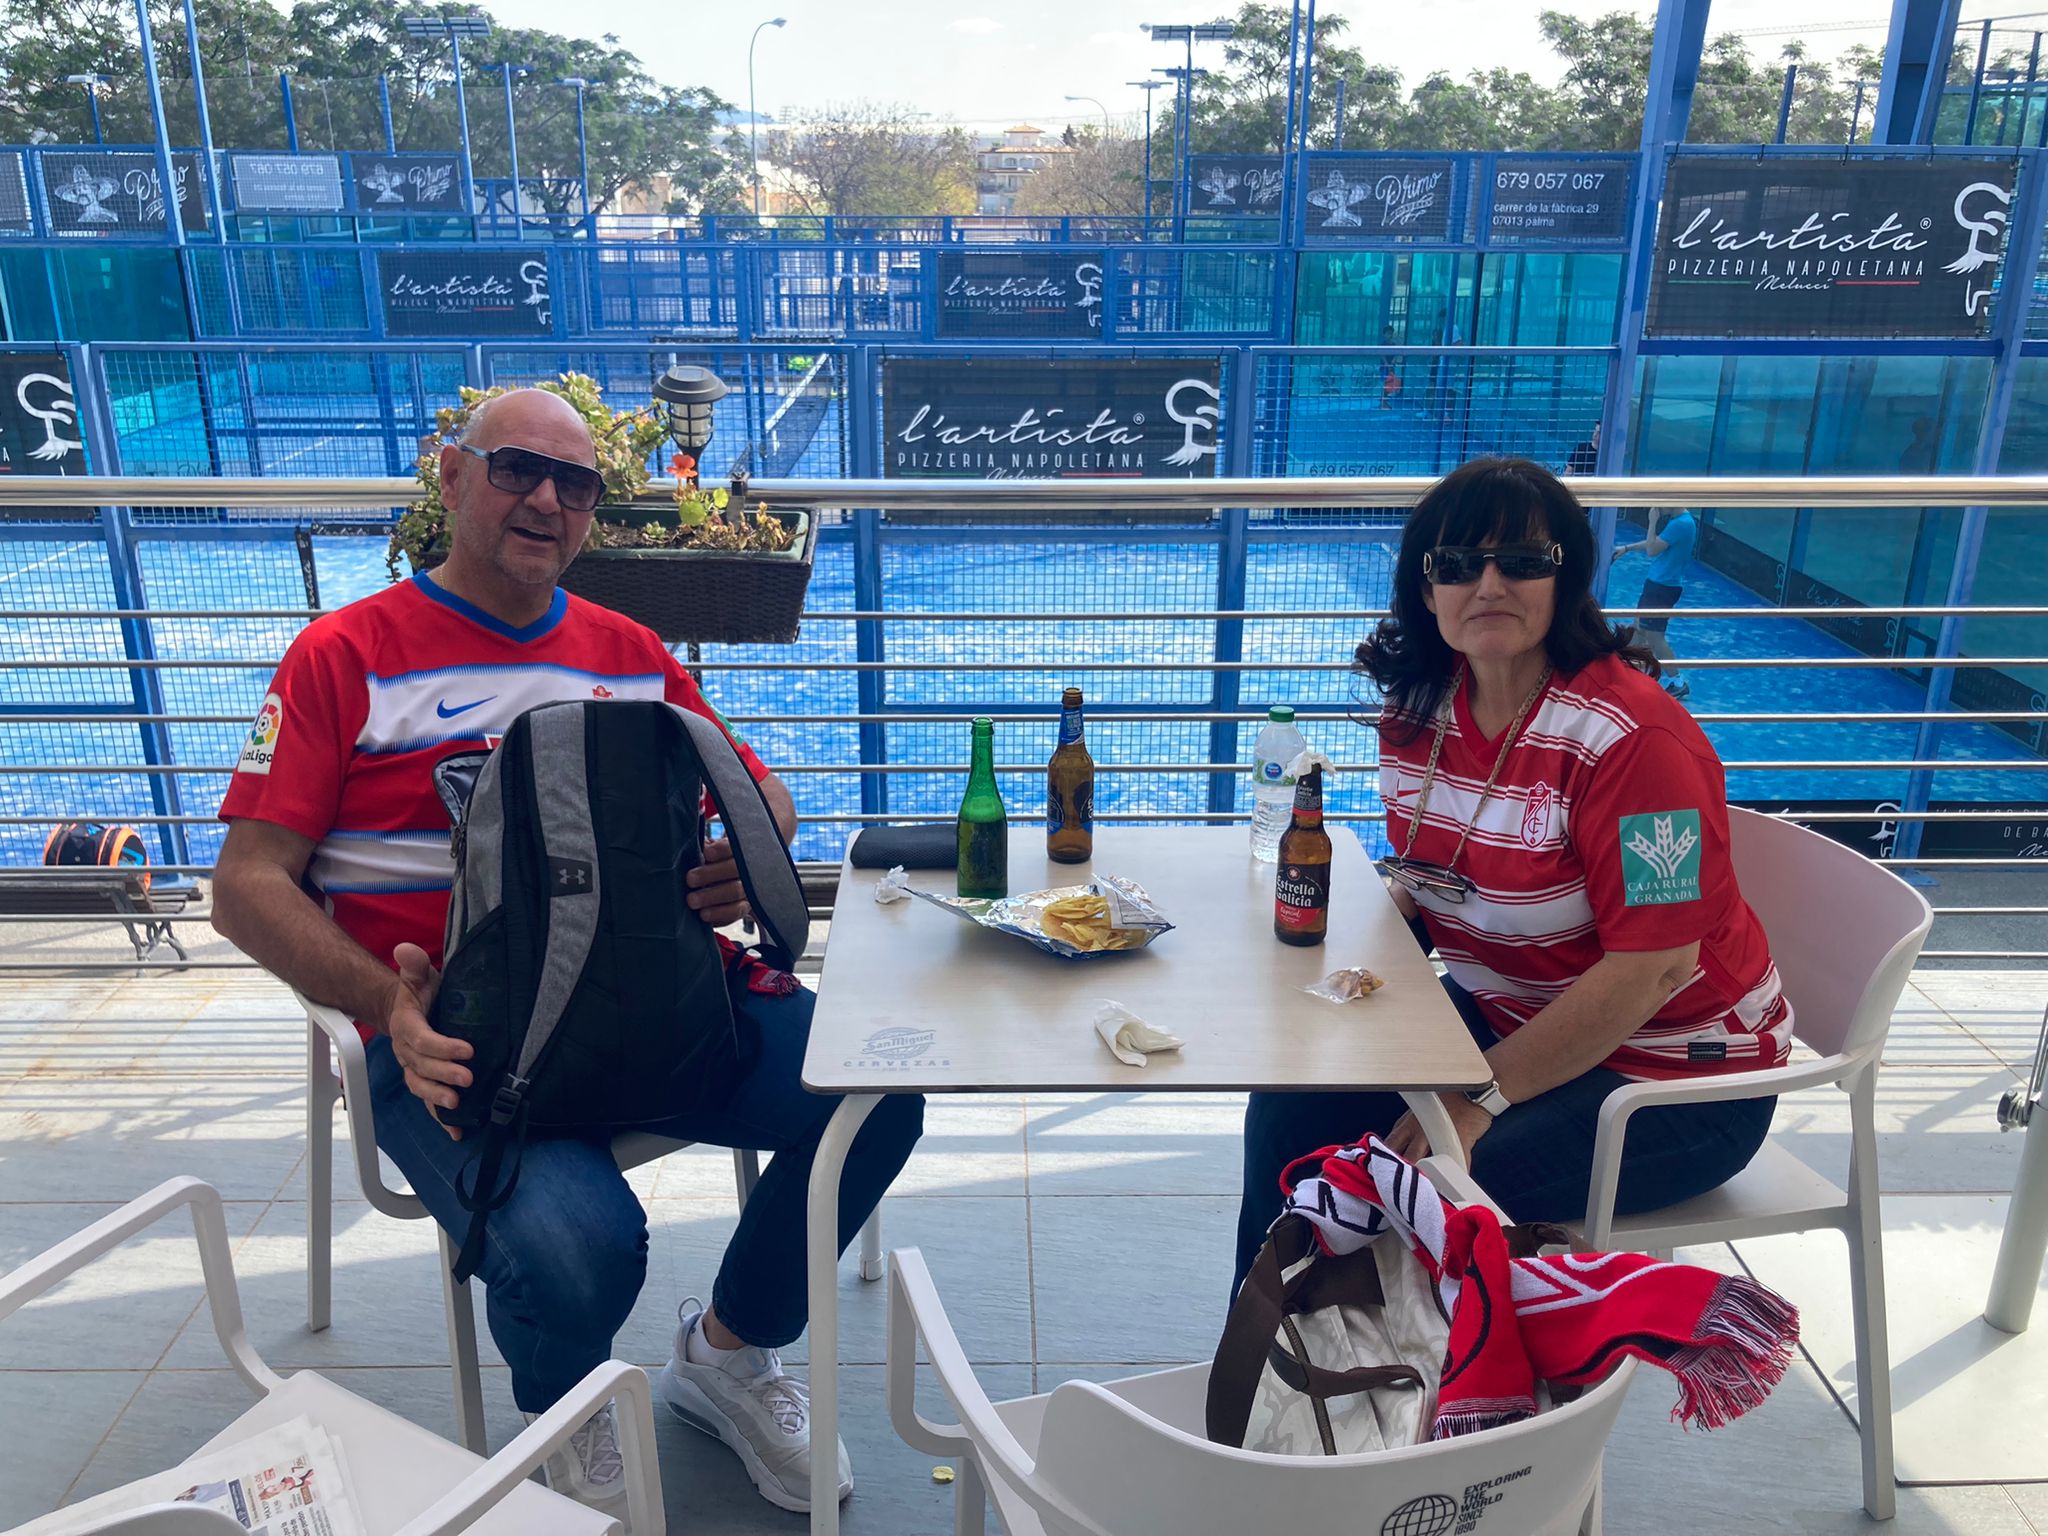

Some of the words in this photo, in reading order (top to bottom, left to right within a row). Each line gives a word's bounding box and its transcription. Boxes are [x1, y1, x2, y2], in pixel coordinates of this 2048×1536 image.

[1497, 172, 1529, 189] 679
[1535, 173, 1567, 189] 057
[1572, 173, 1605, 190] 067
[1375, 172, 1443, 226] Primo
[1494, 203, 1523, 213] carrer
[1525, 203, 1538, 213] de
[1540, 203, 1549, 213] la
[1586, 203, 1599, 213] 29
[1492, 216, 1523, 226] 07013
[1525, 216, 1555, 228] palma
[1668, 259, 1768, 275] PIZZERIA
[1786, 260, 1924, 276] NAPOLETANA
[1754, 274, 1832, 290] Melucci
[898, 452, 996, 468] PIZZERIA
[1011, 452, 1144, 468] NAPOLETANA
[1339, 465, 1365, 477] 057
[1369, 465, 1394, 477] 067
[2003, 826, 2023, 838] DE
[1276, 875, 1315, 895] Estrella
[1627, 881, 1660, 892] CAJA
[1663, 876, 1697, 889] RURAL
[1276, 886, 1312, 907] Galicia
[1634, 890, 1693, 904] GRANADA
[1464, 1466, 1532, 1495] EXPLORING
[1460, 1493, 1503, 1513] WORLD
[1463, 1490, 1487, 1504] THE
[1457, 1507, 1484, 1525] SINCE
[1455, 1520, 1477, 1535] 1890
